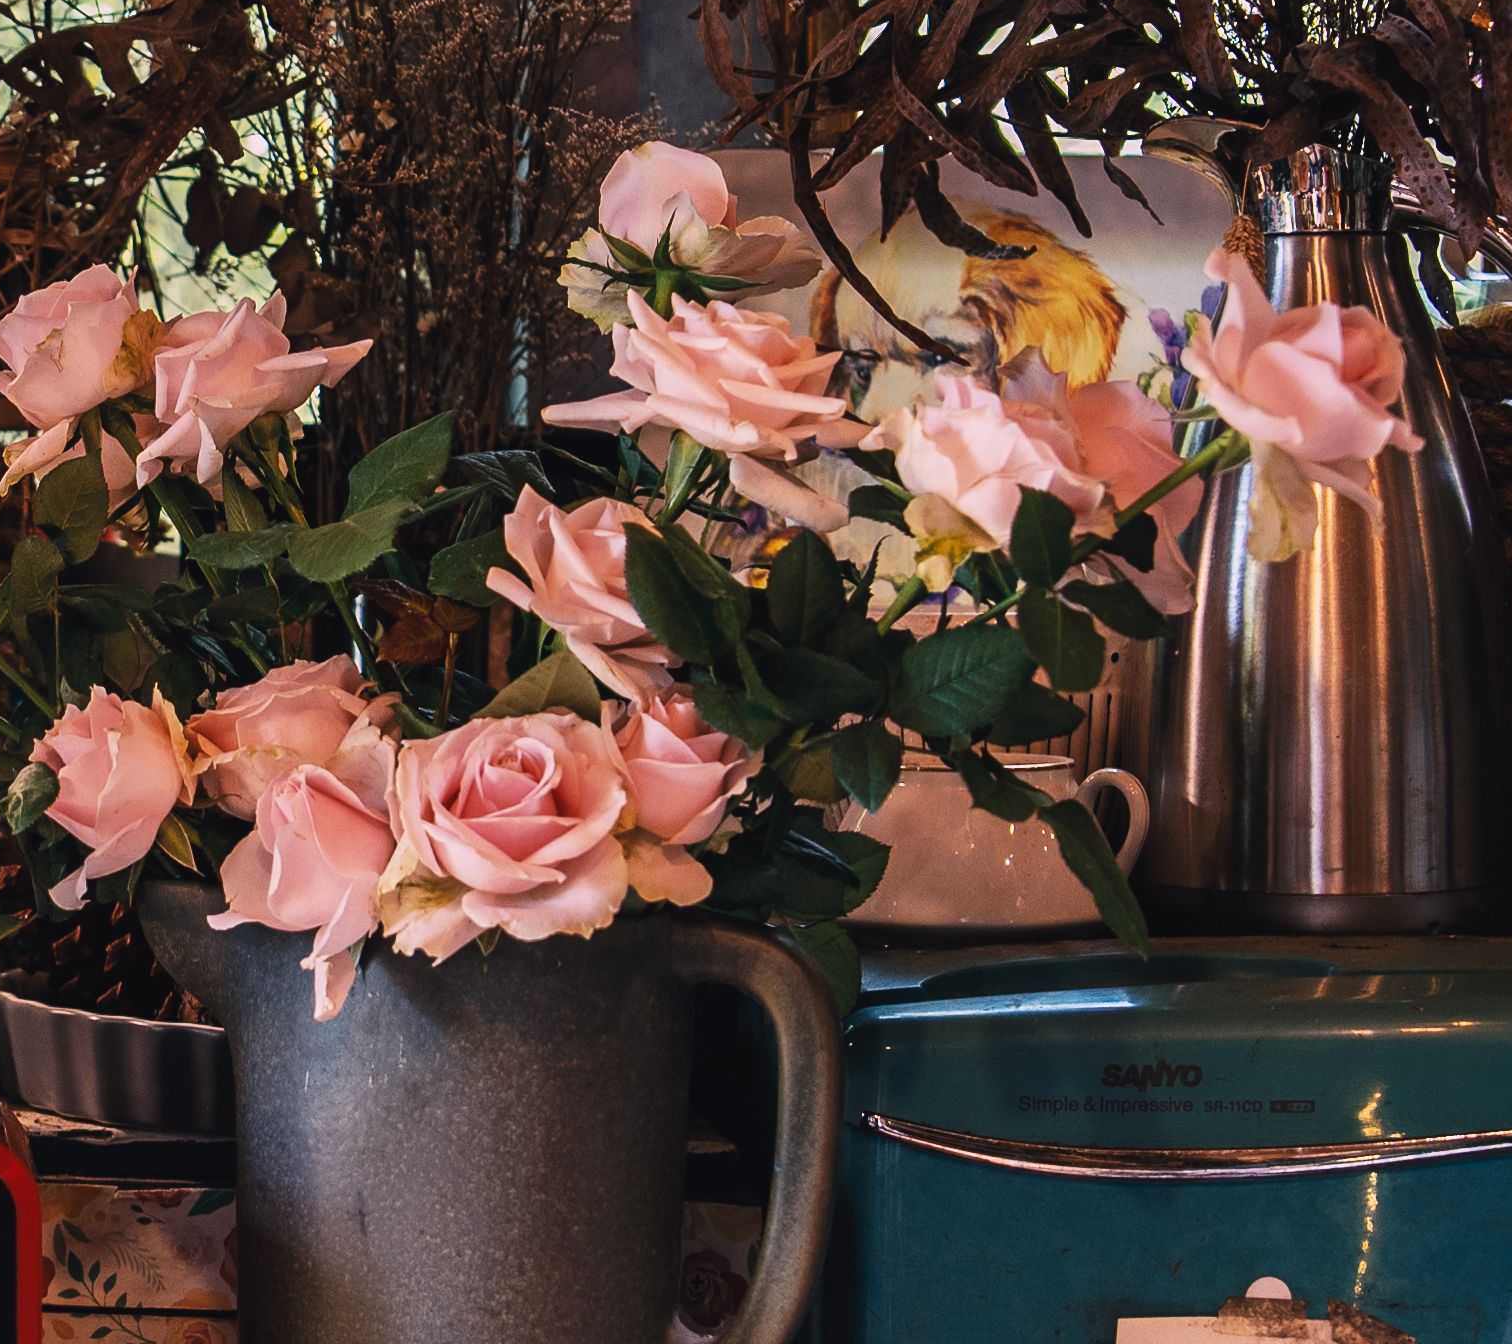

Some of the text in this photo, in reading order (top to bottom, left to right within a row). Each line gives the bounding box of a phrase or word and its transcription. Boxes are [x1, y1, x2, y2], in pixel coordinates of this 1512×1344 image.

[1101, 1061, 1204, 1093] SANYO
[1018, 1096, 1079, 1116] Simple
[1083, 1096, 1096, 1114] &
[1099, 1097, 1194, 1116] Impressive
